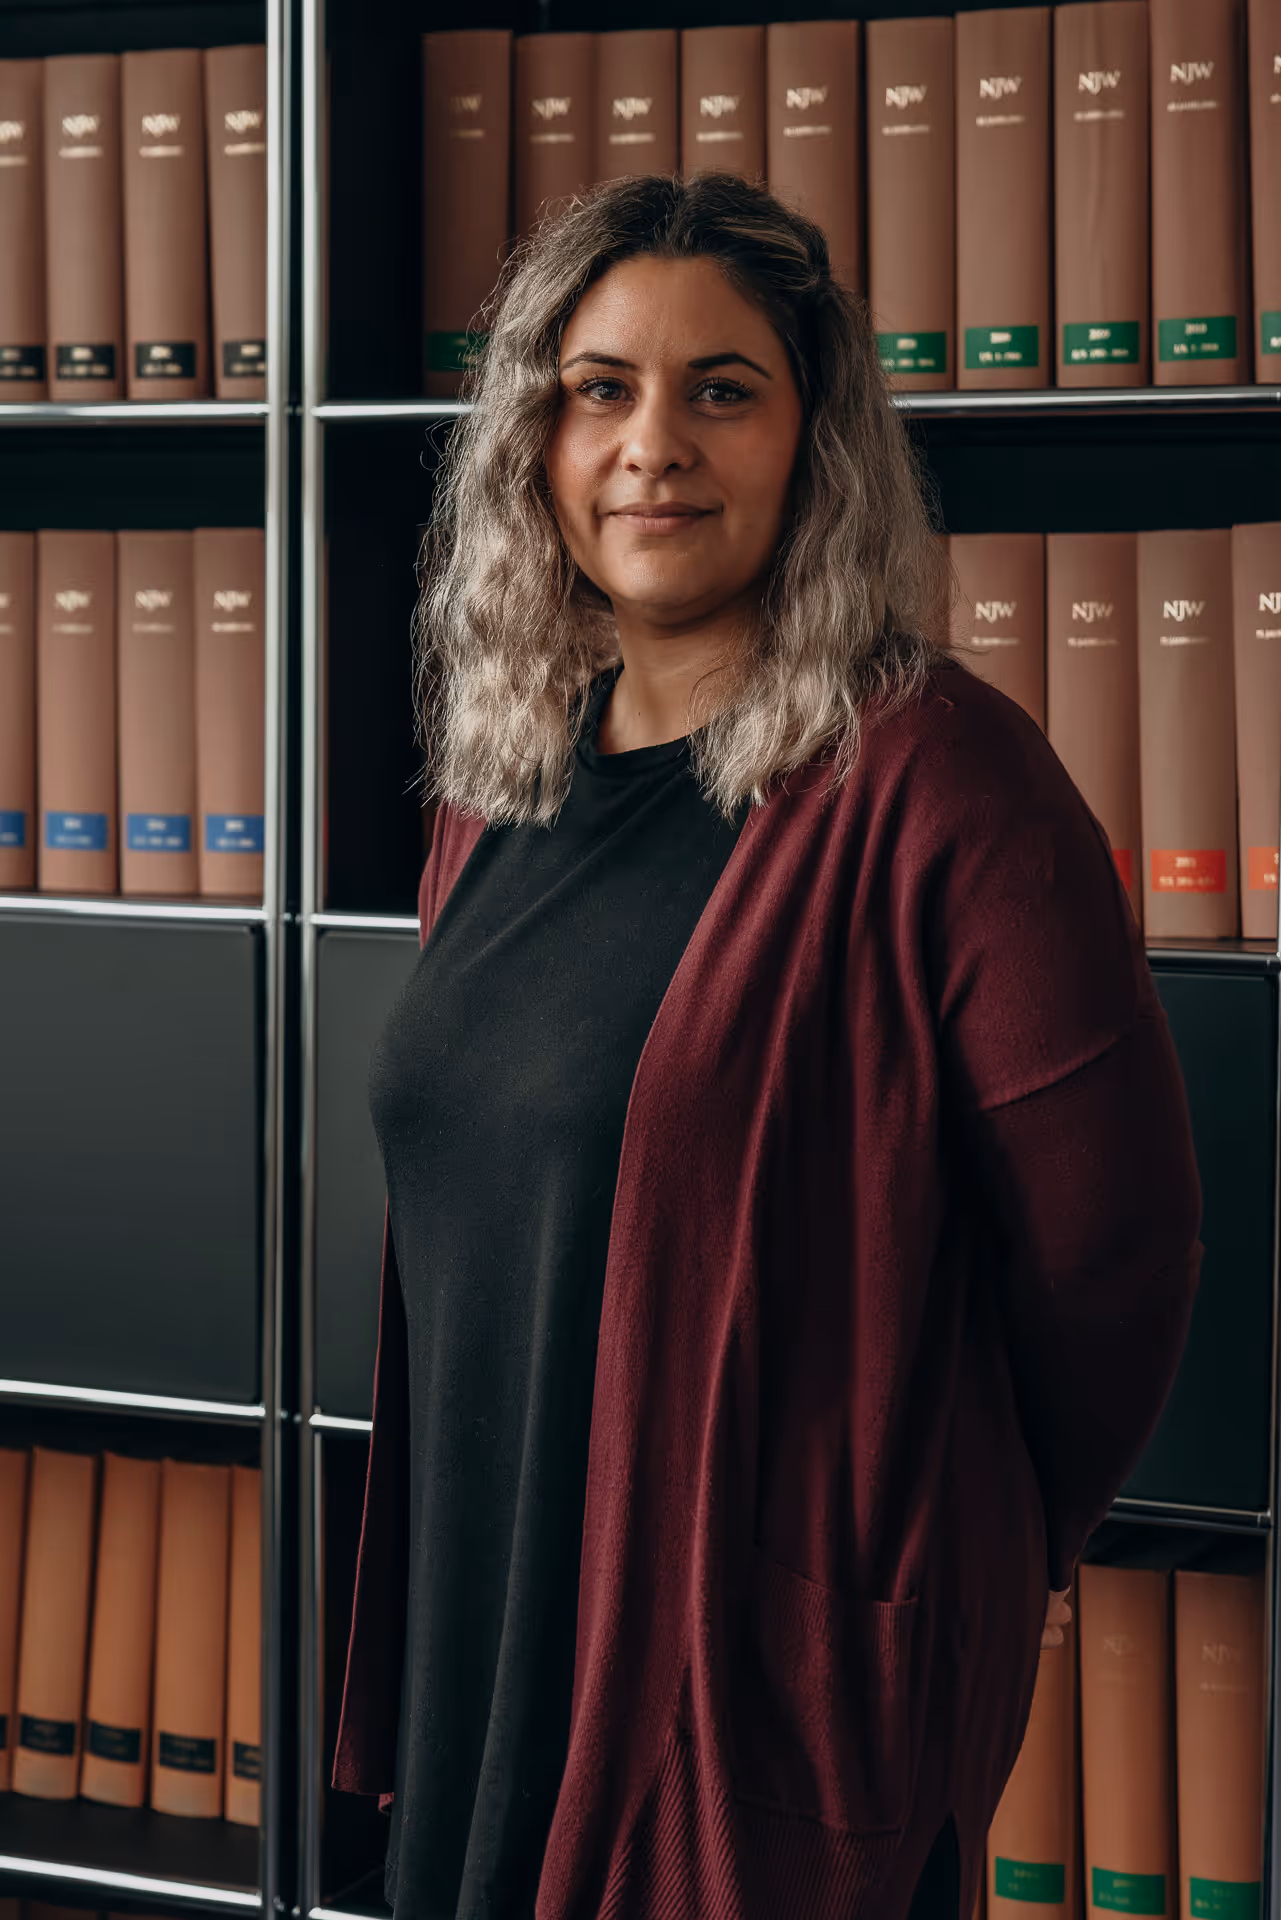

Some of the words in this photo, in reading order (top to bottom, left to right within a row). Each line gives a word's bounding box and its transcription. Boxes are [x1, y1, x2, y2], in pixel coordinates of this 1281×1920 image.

[1079, 71, 1121, 94] NJW
[1171, 62, 1214, 84] NJW
[980, 77, 1021, 99] NJW
[975, 601, 1017, 623] NJW
[1072, 601, 1114, 623] NJW
[1163, 600, 1206, 621] NJW
